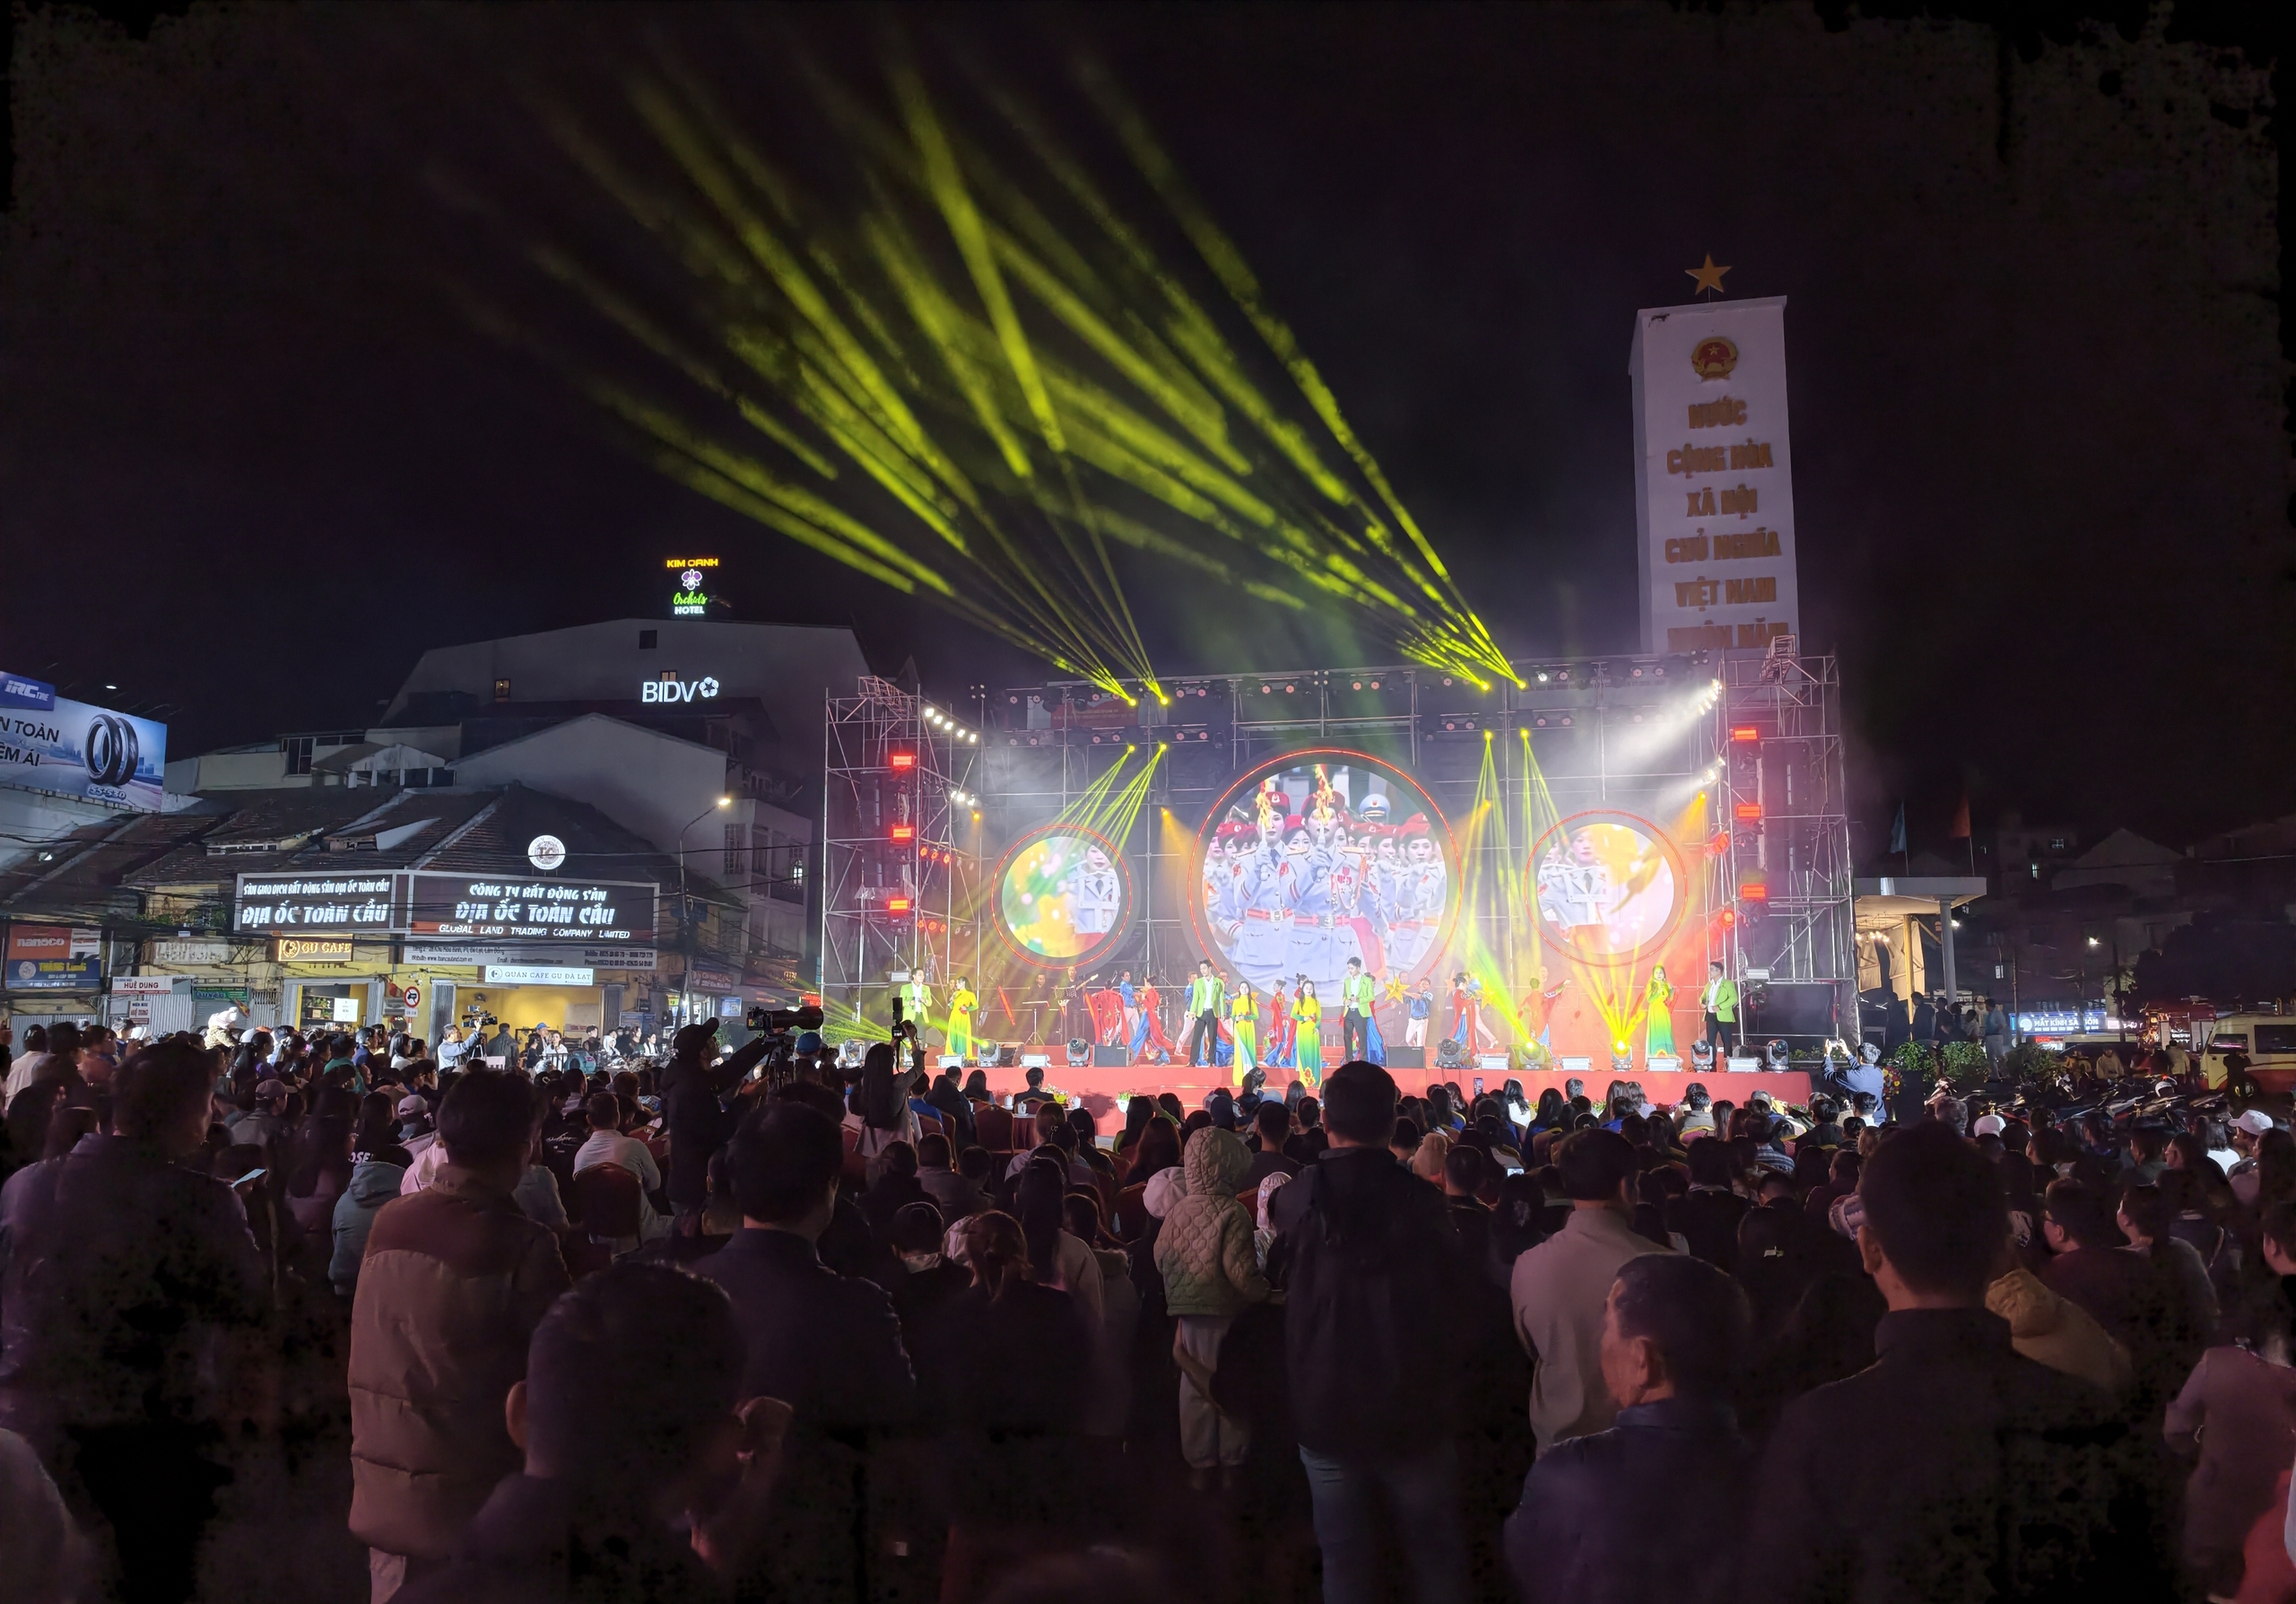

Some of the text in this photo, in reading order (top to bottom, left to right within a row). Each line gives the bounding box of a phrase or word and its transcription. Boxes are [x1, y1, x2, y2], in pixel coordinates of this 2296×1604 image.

[666, 558, 718, 568] KIM OANH
[674, 590, 708, 606] Orchids
[1674, 576, 1777, 612] VIỆT NAM
[674, 606, 705, 615] HOTEL
[642, 681, 699, 702] BIDV
[14, 719, 60, 743] TOÀN
[23, 749, 40, 767] ÁI
[243, 882, 257, 895] SÀN
[257, 883, 271, 894] GIAO
[358, 879, 376, 893] TOÀN
[376, 878, 390, 893] CẦU
[469, 882, 501, 897] CÔNG
[546, 885, 579, 902] ĐỘNG
[582, 886, 607, 902] SẢN
[241, 898, 389, 928] ĐỊA ỐC TOÀN CẦU
[455, 898, 616, 925] ĐỊA ỐC TOÀN CẦU
[439, 924, 631, 939] GLOBAL LAND TRADING COMPANY LIMITED
[301, 942, 352, 954] GU CAFE
[2050, 1016, 2067, 1026] KÍNH
